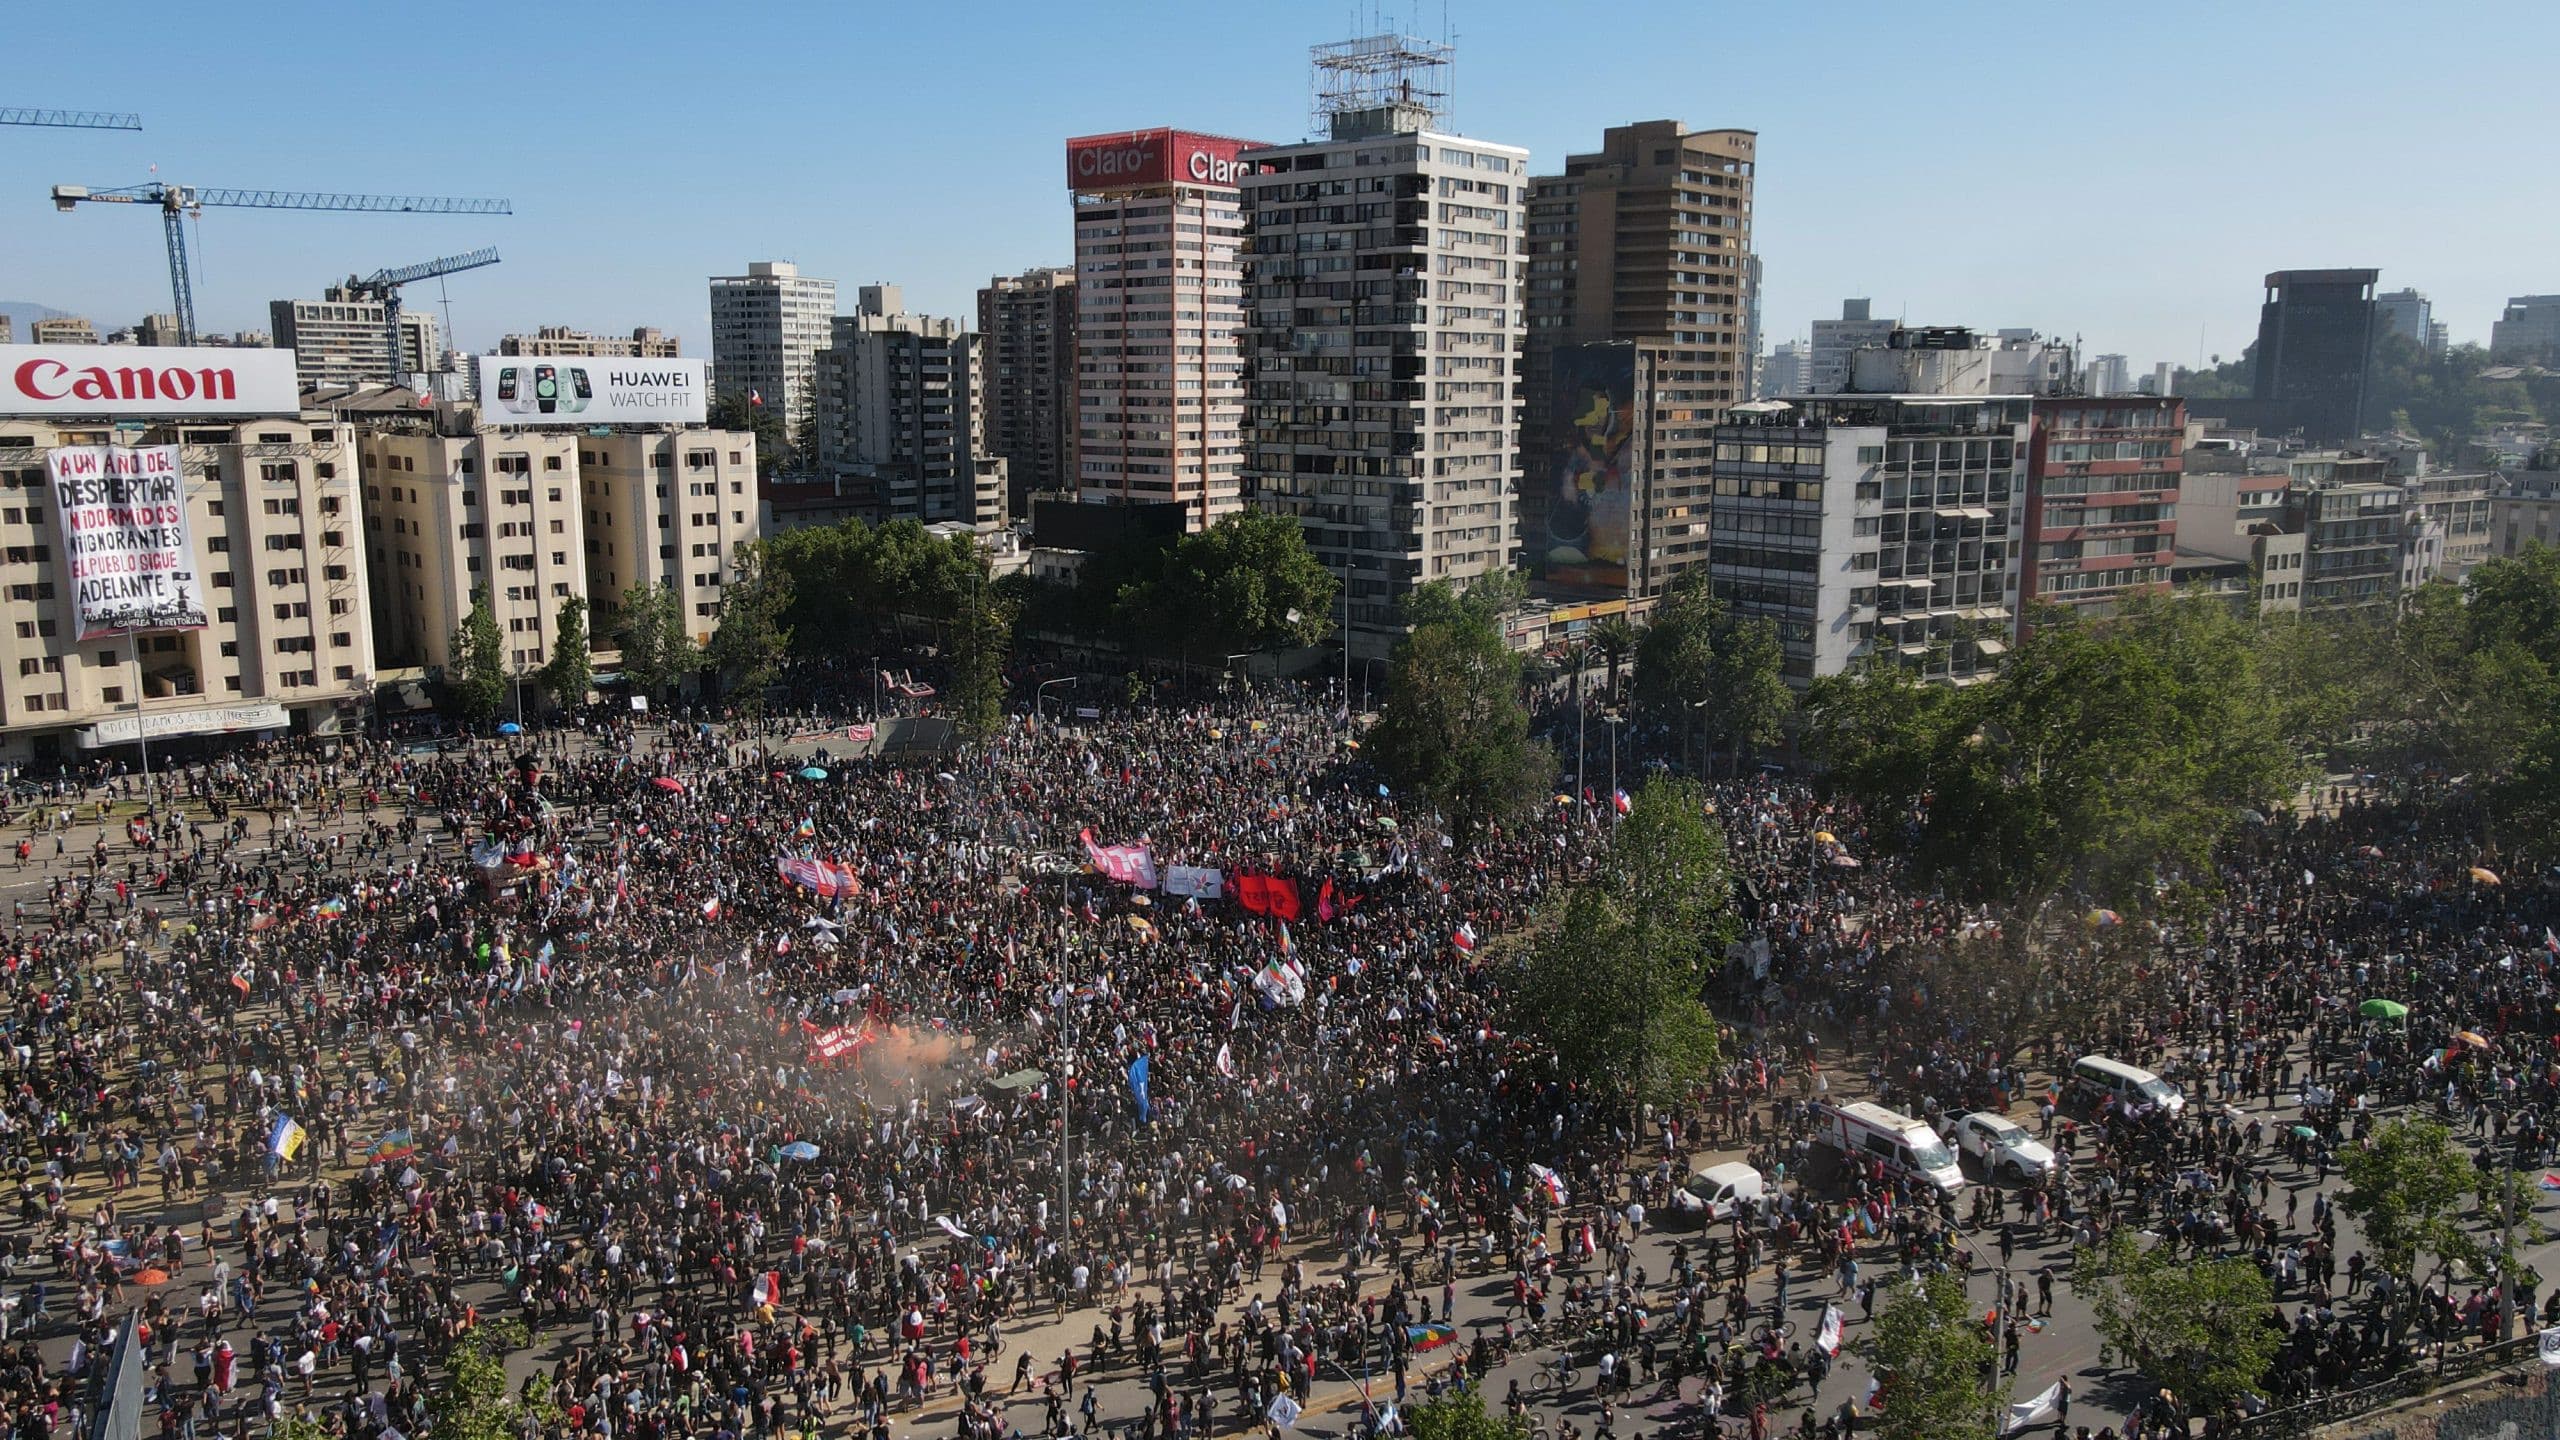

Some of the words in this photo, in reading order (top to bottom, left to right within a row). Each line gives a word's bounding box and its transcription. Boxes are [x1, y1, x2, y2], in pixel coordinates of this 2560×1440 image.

[1078, 146, 1142, 176] Claro
[14, 359, 236, 400] Canon
[610, 372, 689, 386] HUAWEI
[610, 392, 668, 407] WATCH
[671, 392, 691, 407] FIT
[60, 456, 71, 476] A
[74, 453, 97, 474] UN
[104, 453, 140, 474] AÑO
[147, 451, 174, 472] DEL
[58, 476, 176, 508] DESPERTAR
[72, 559, 89, 579] EL
[90, 553, 136, 577] PUEBLO
[78, 574, 165, 604] ADELANTE
